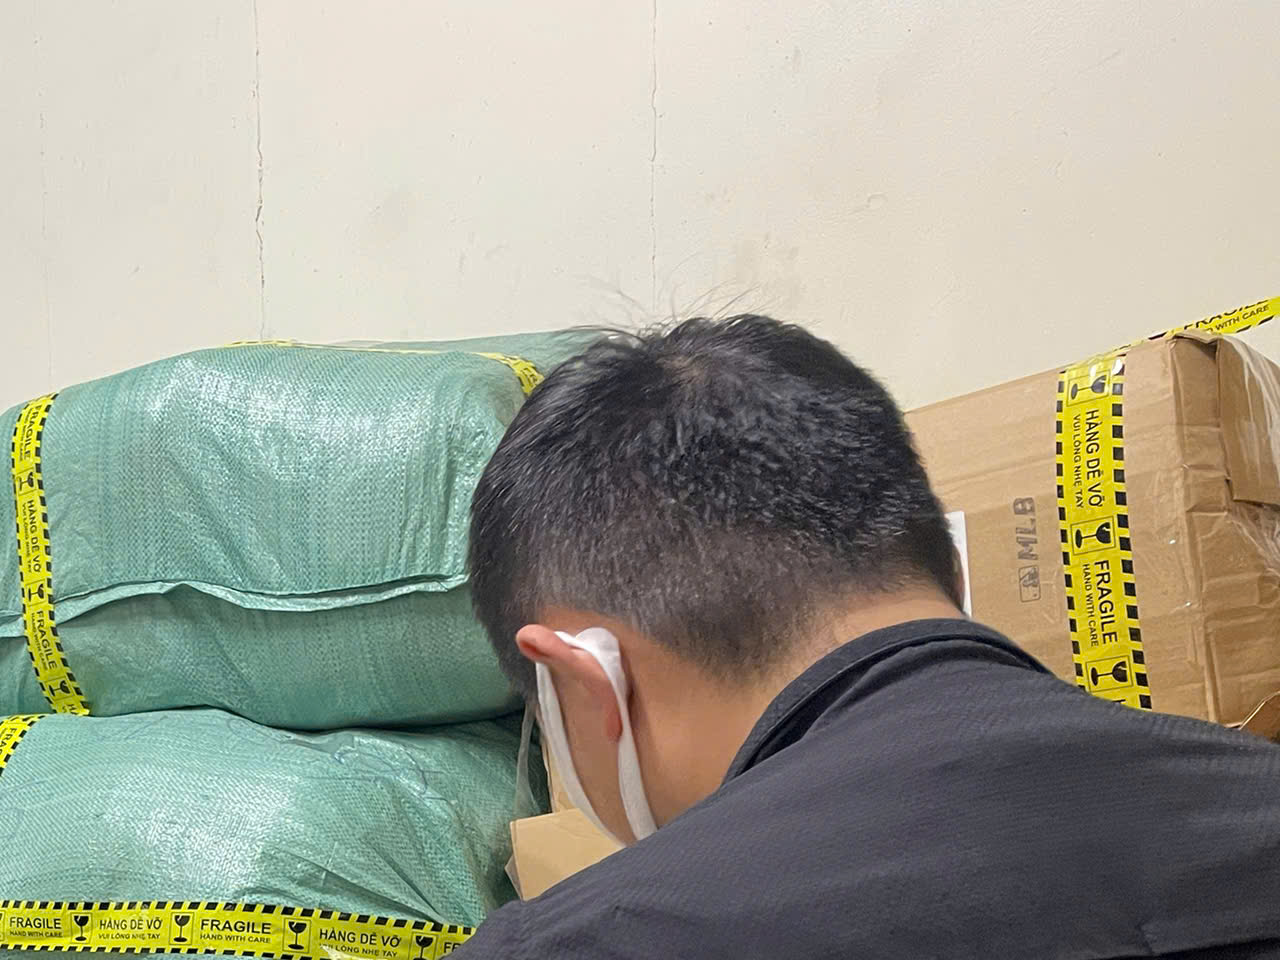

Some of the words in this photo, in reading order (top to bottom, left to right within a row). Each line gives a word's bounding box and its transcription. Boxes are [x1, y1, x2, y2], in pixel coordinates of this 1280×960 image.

[1215, 316, 1240, 331] WITH
[1242, 303, 1270, 320] CARE
[1073, 414, 1081, 432] VUI
[1085, 409, 1103, 455] HÀNG
[1075, 489, 1083, 508] TAY
[1083, 563, 1093, 592] HAND
[1085, 593, 1095, 618] WITH
[1094, 560, 1118, 645] FRAGILE
[36, 610, 57, 669] FRAGILE
[1088, 620, 1099, 647] CARE
[9, 917, 62, 930] FRAGILE
[200, 918, 272, 935] FRAGILE
[319, 926, 356, 943] HÀNG
[200, 933, 223, 941] HAND
[224, 934, 246, 942] WITH
[248, 936, 271, 944] CARE
